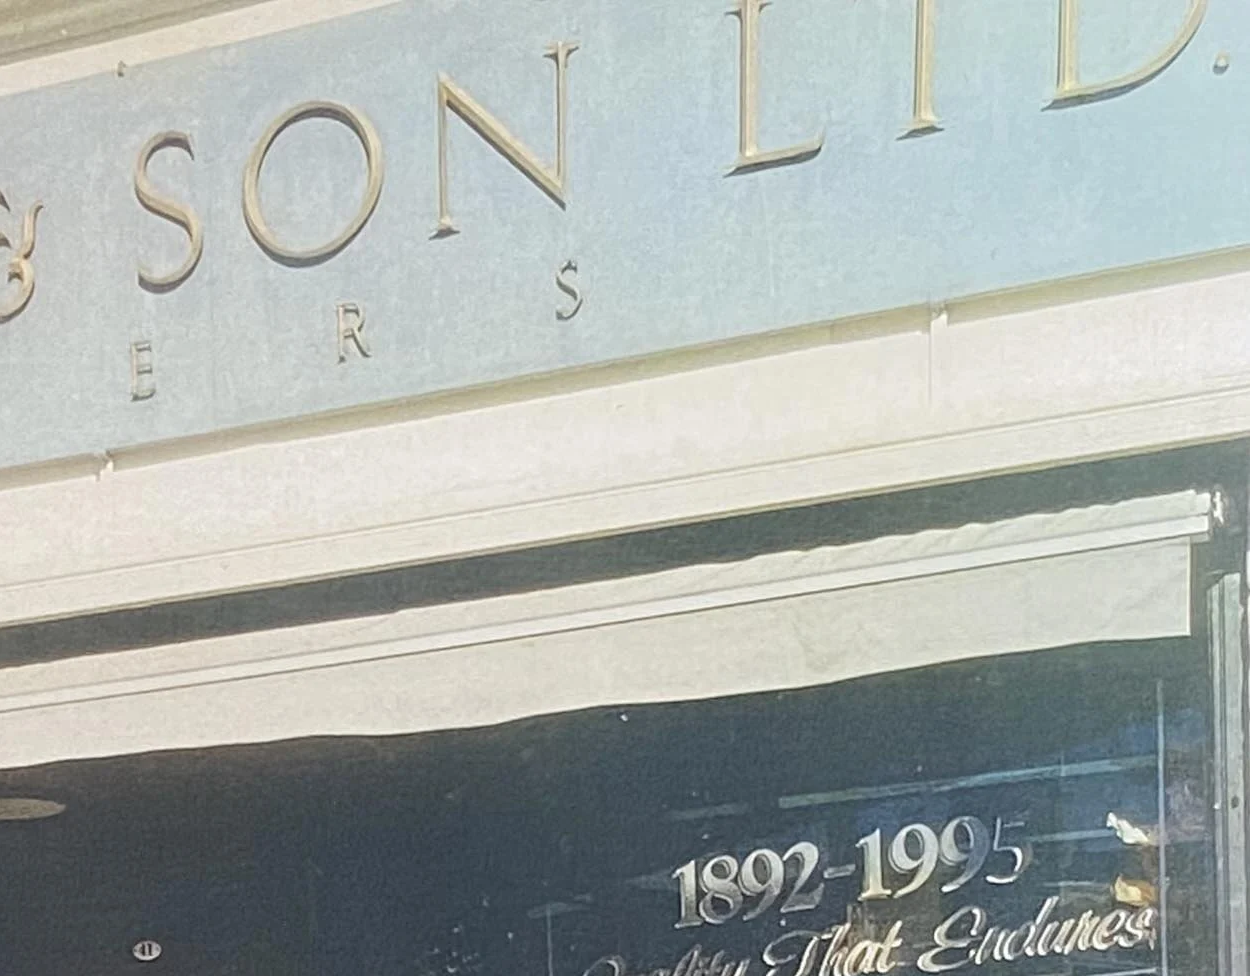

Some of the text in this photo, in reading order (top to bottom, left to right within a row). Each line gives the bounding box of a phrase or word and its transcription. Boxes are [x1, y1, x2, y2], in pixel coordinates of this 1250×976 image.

[133, 41, 580, 294] SON
[672, 815, 1028, 930] 1892-1995
[916, 895, 1158, 973] Endures
